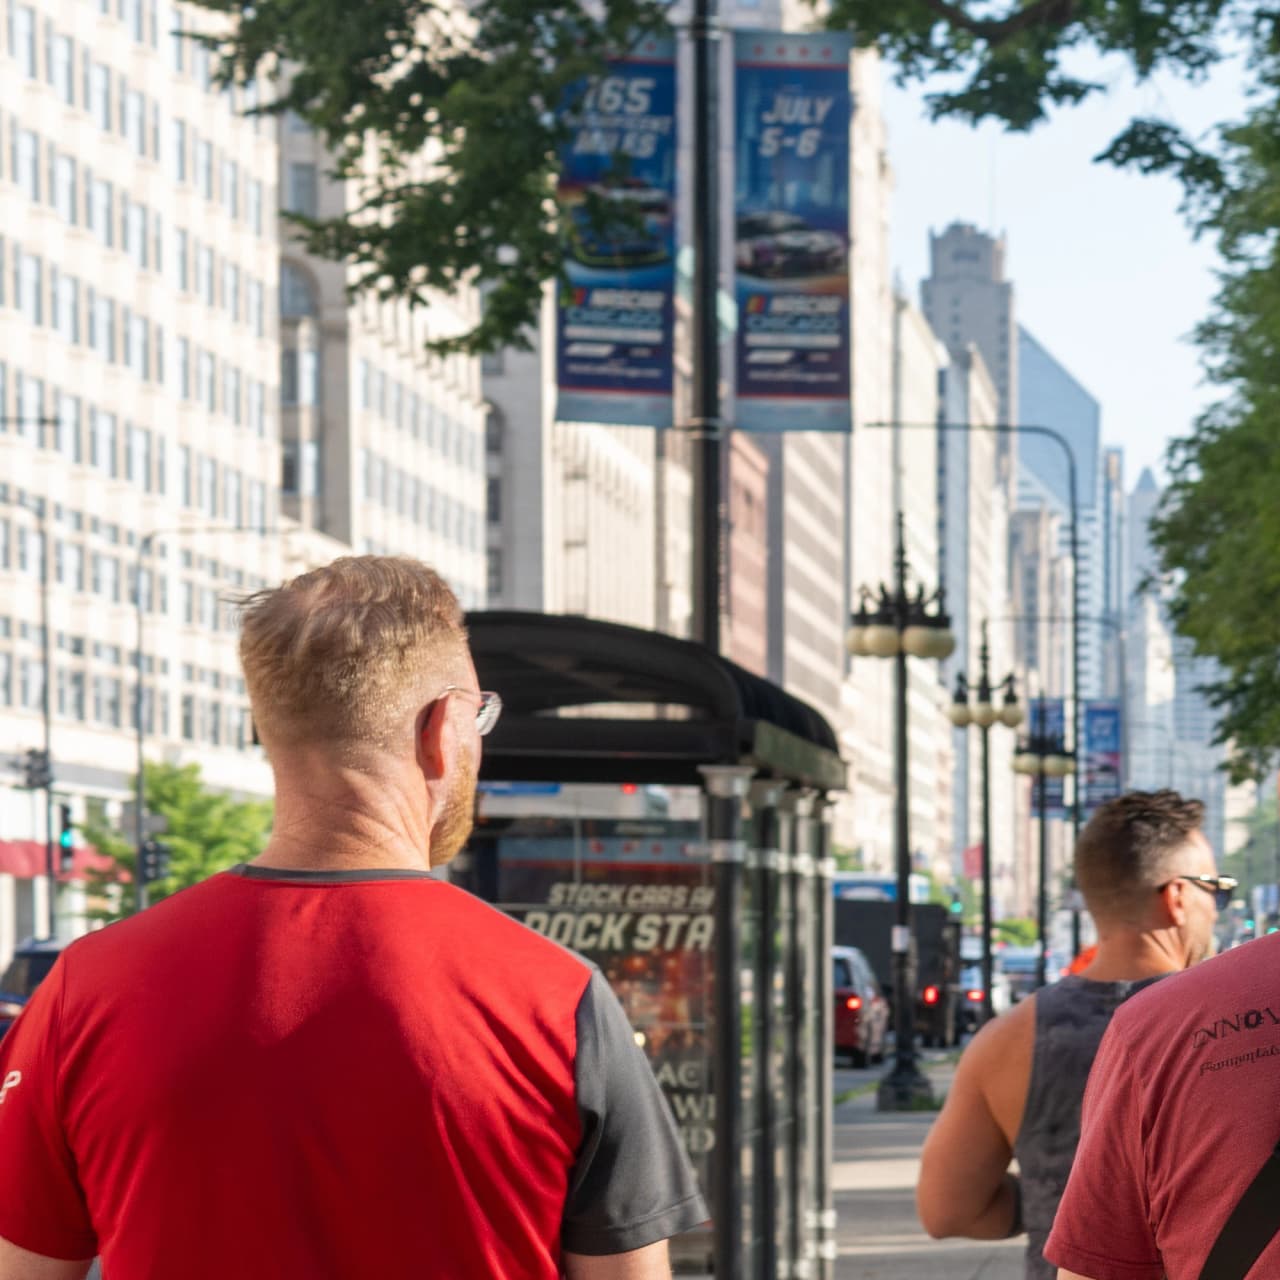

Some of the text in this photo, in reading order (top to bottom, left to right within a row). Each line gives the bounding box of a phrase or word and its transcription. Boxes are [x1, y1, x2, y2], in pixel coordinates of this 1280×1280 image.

[762, 96, 831, 123] JULY
[760, 128, 821, 157] 5-6
[549, 884, 626, 906] STOCK
[626, 886, 687, 907] CARS
[632, 915, 715, 951] STA
